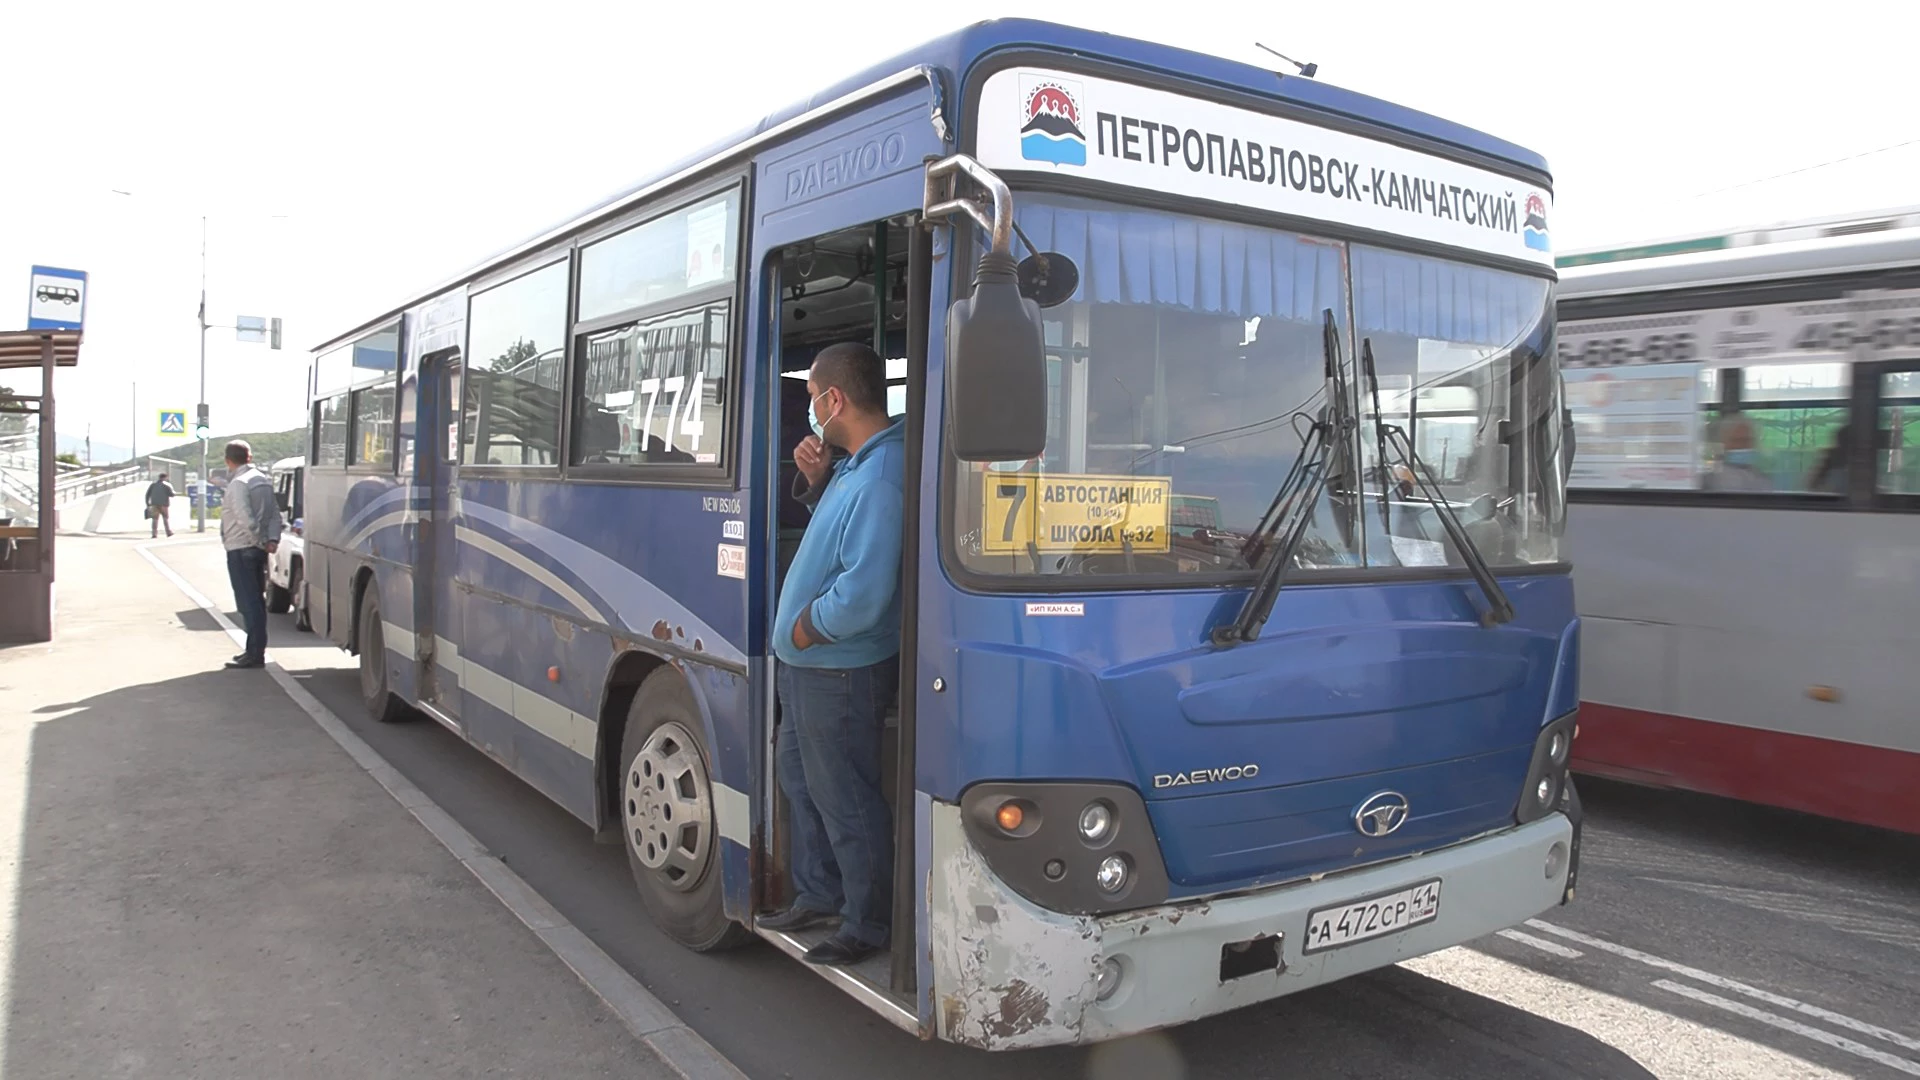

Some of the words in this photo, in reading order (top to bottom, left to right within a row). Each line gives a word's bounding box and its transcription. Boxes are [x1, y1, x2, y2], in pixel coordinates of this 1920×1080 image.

[785, 132, 905, 202] DAEWOO
[1096, 111, 1518, 234] ПЕТРОПАВЛОВСК-КАМЧАТСКИЙ
[702, 496, 719, 512] NEW
[719, 497, 741, 514] BS106
[1044, 485, 1162, 507] АВТОСТАНЦИЯ
[996, 485, 1027, 542] 7
[1087, 505, 1102, 521] (10
[1051, 525, 1116, 543] ШКОЛА
[1119, 525, 1155, 543] №32
[1047, 605, 1062, 613] КАН
[1154, 764, 1259, 788] DAEWOO
[1412, 885, 1432, 909] 41
[1410, 909, 1425, 920] RUS
